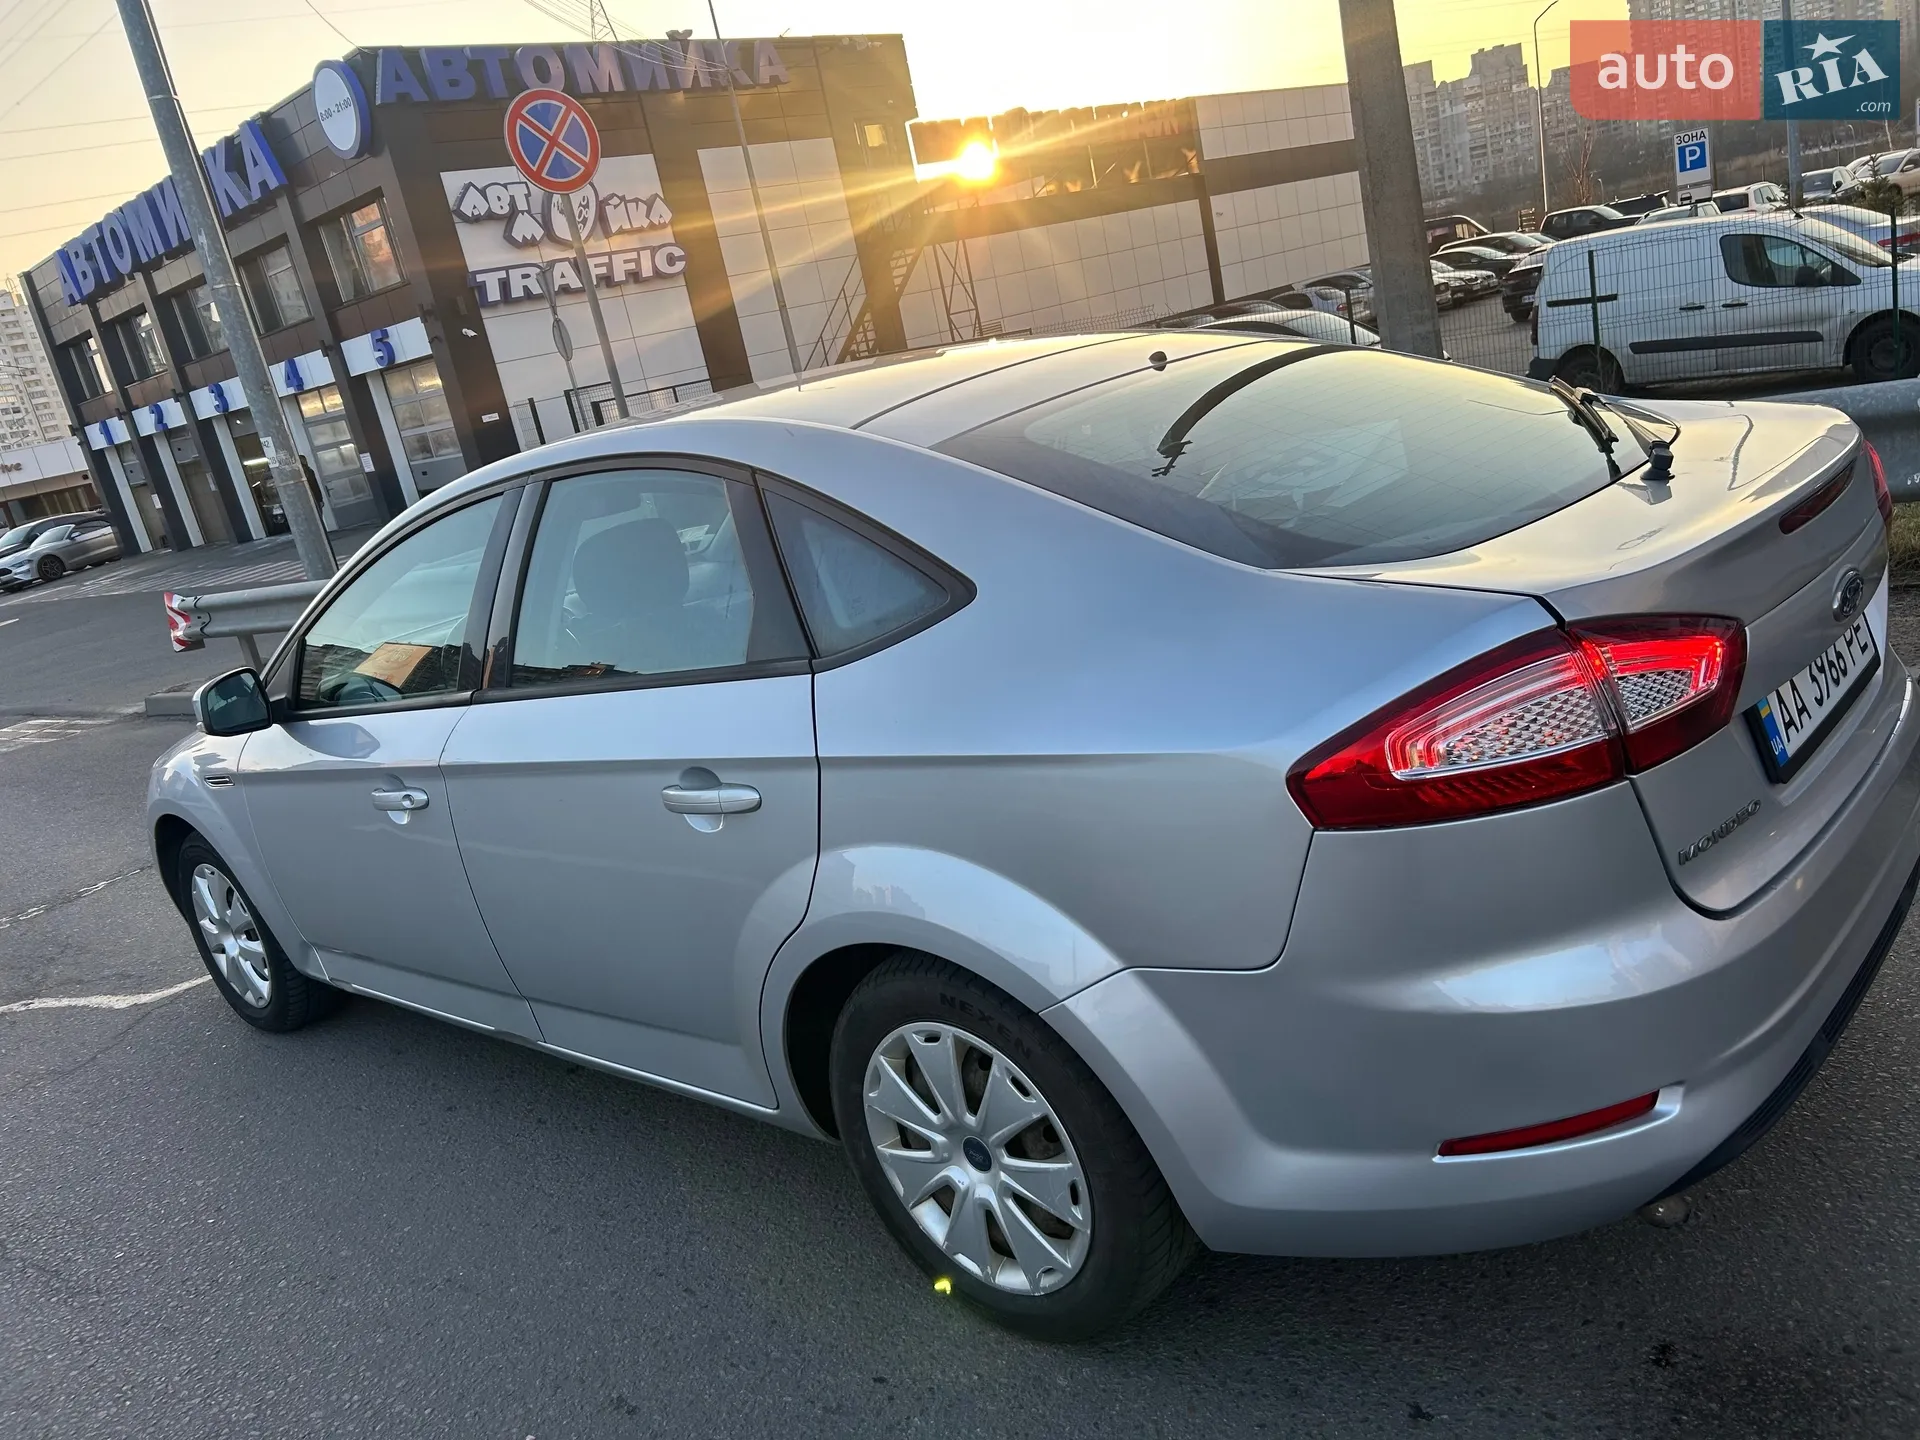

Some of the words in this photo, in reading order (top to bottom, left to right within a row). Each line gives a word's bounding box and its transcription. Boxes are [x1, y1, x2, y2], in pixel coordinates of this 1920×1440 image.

[376, 29, 790, 104] АВТОМИЙКА
[1676, 130, 1707, 145] ЗОНА
[1685, 146, 1701, 169] P
[55, 119, 288, 308] АВТОМИКА
[474, 245, 687, 303] TRAFFIC
[371, 329, 396, 367] 5
[284, 358, 305, 392] 4
[208, 383, 230, 413] 3
[99, 420, 113, 446] 1
[149, 403, 168, 432] 2
[1776, 678, 1812, 743] AA
[1771, 735, 1784, 755] UA
[1678, 799, 1762, 866] MONDEO
[939, 992, 1032, 1060] NEXEN
